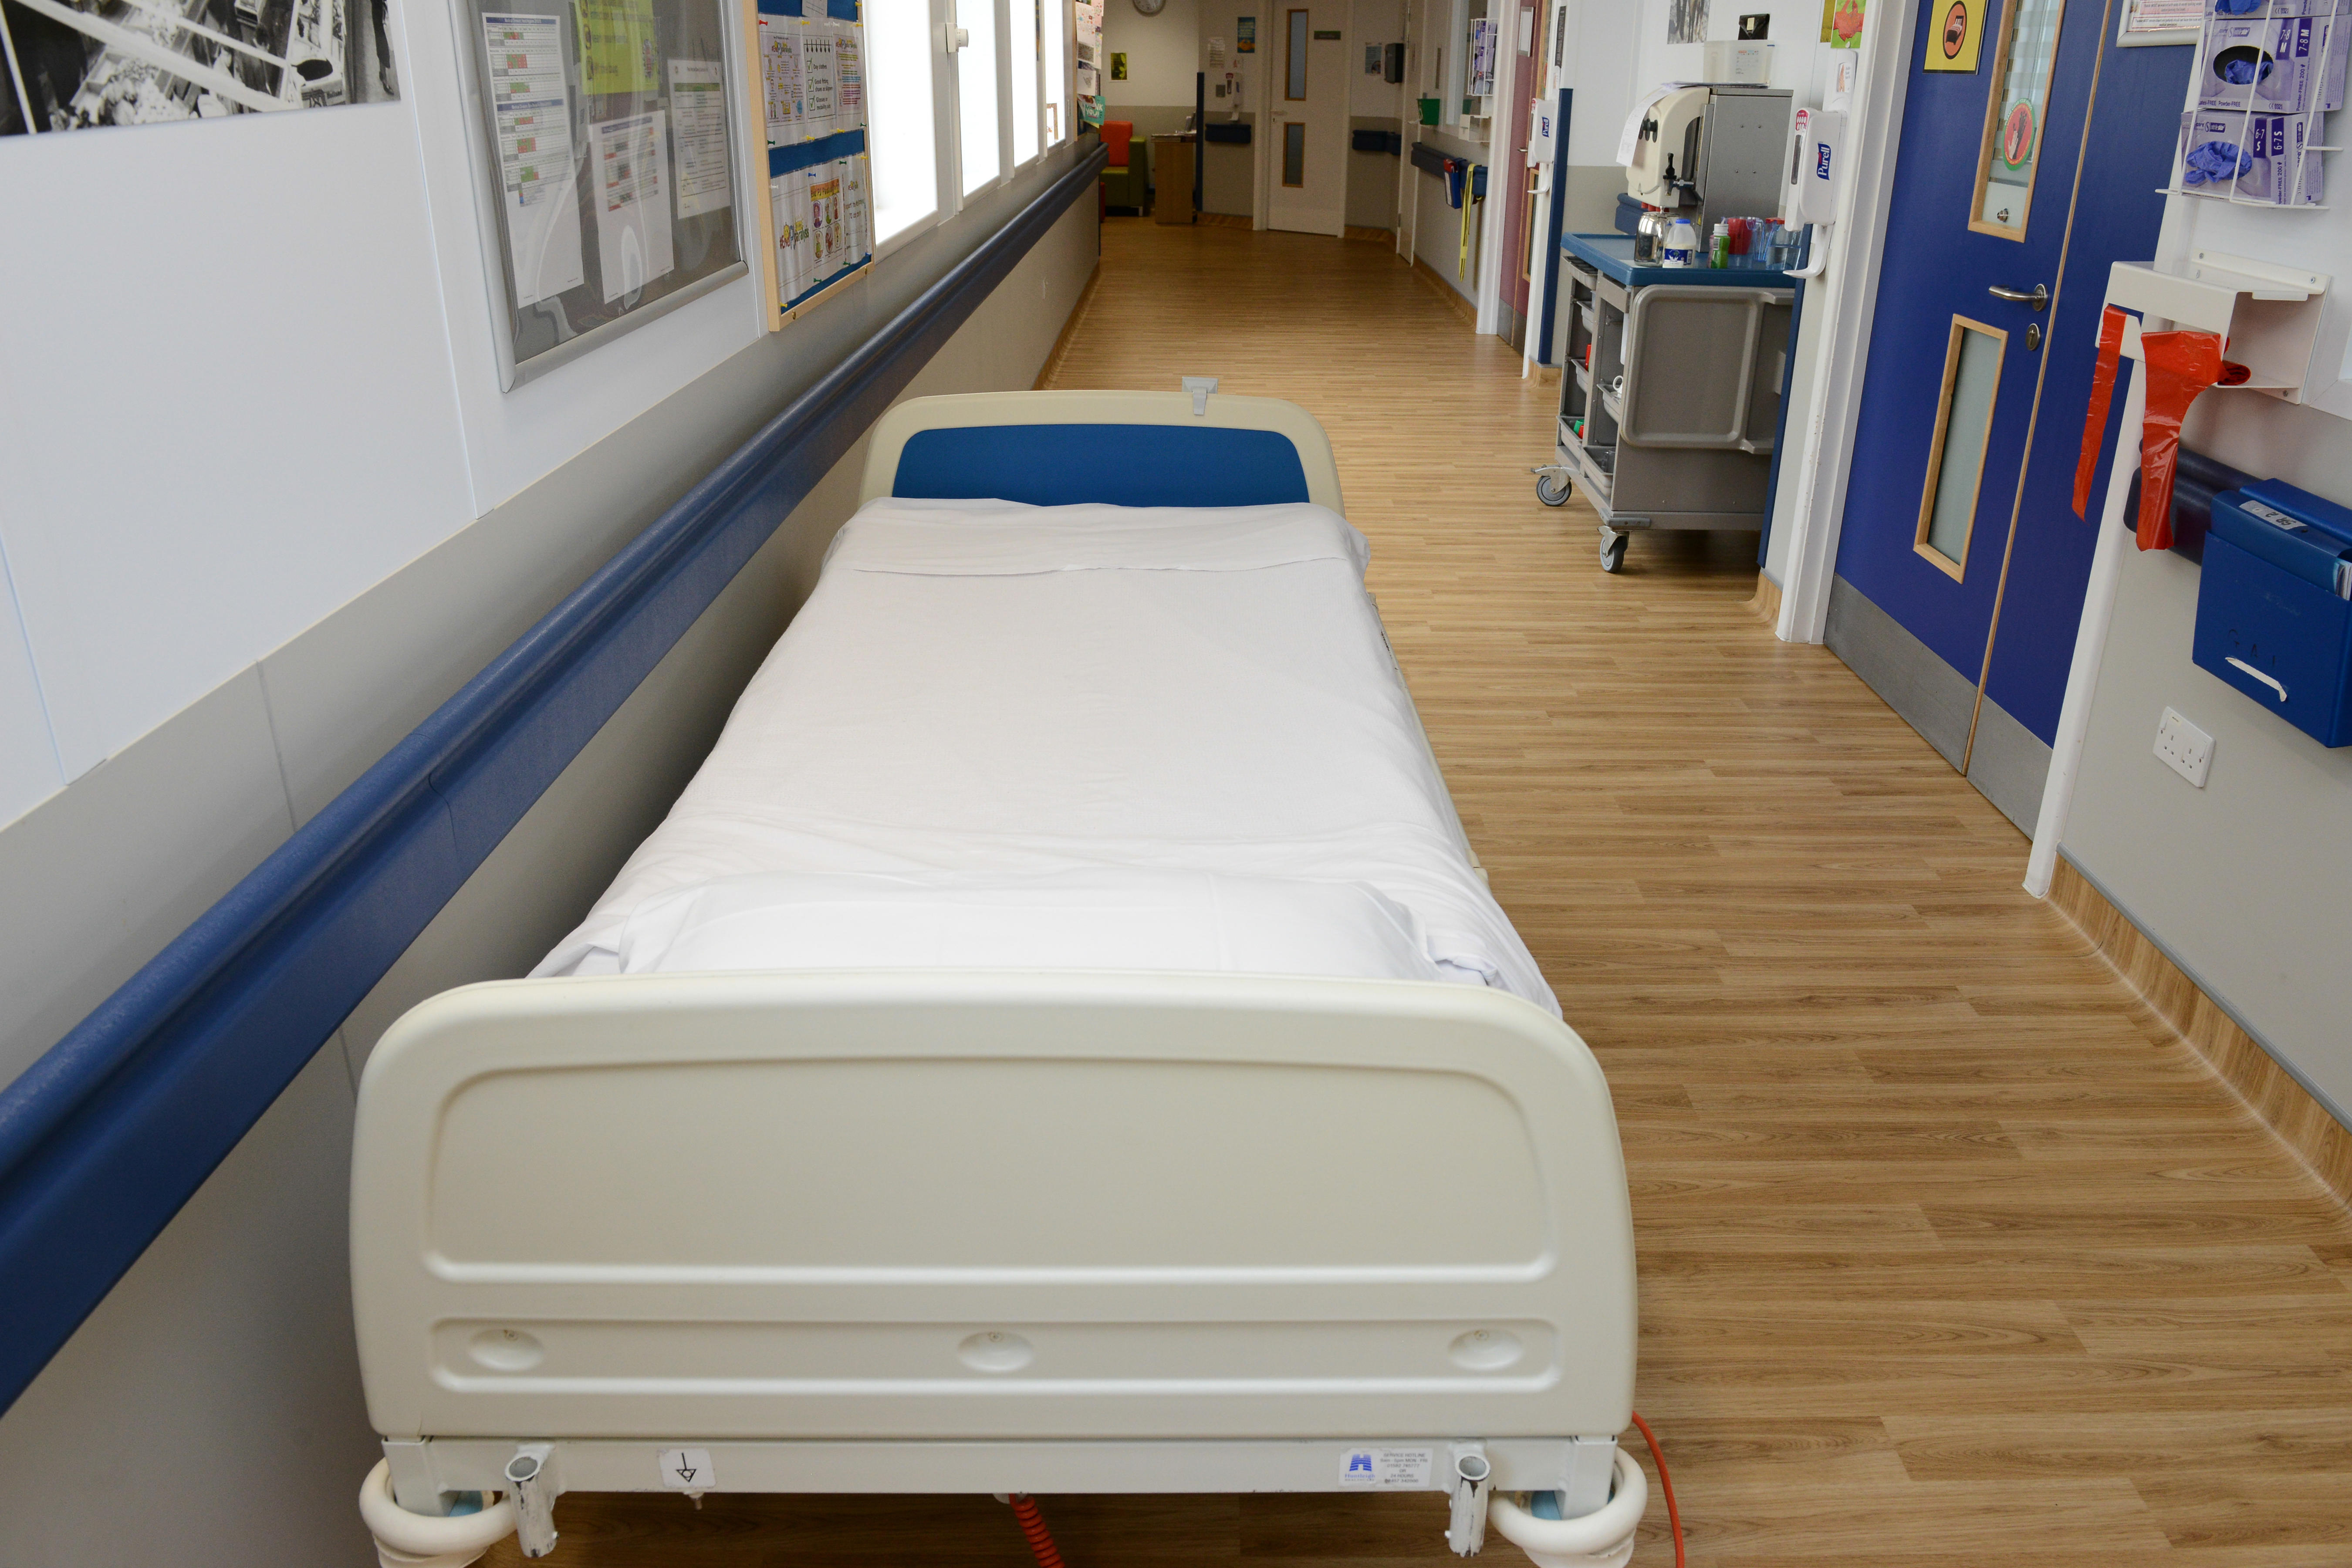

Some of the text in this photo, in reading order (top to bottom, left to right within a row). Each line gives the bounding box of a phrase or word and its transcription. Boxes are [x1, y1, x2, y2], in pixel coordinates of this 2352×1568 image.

[2280, 30, 2291, 40] 7-8
[2280, 43, 2287, 53] M
[2299, 39, 2308, 51] 7-8
[2296, 79, 2304, 111] Powder-FREE
[2255, 129, 2264, 139] 6-7
[2257, 141, 2261, 151] S
[2274, 137, 2282, 150] 6-7
[1817, 147, 1830, 176] Purell
